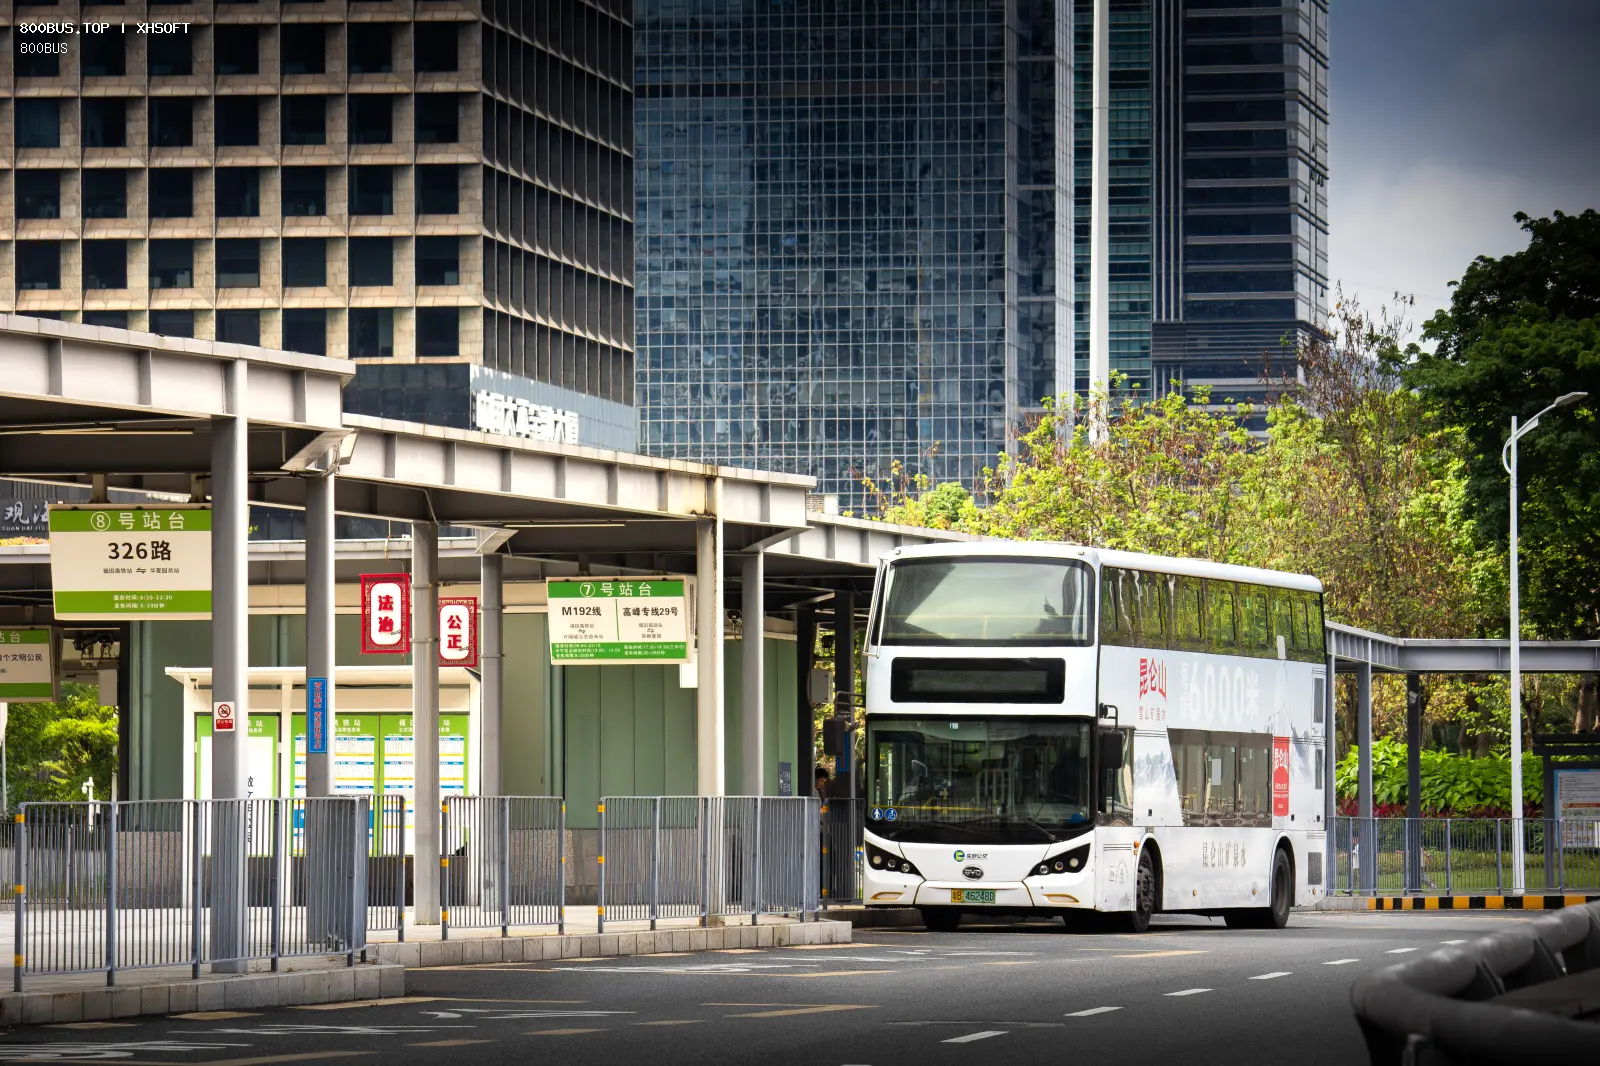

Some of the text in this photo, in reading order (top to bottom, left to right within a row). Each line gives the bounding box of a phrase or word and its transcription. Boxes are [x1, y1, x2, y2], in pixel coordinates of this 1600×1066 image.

[107, 540, 172, 561] 326路
[377, 594, 394, 633] 法治
[561, 606, 679, 617] M192线 高峰专线29号
[446, 615, 463, 649] 公正
[1139, 657, 1167, 701] 昆仑山
[1189, 661, 1260, 724] 6000米
[1202, 840, 1248, 869] 昆仑山矿泉水
[964, 868, 982, 876] BYD
